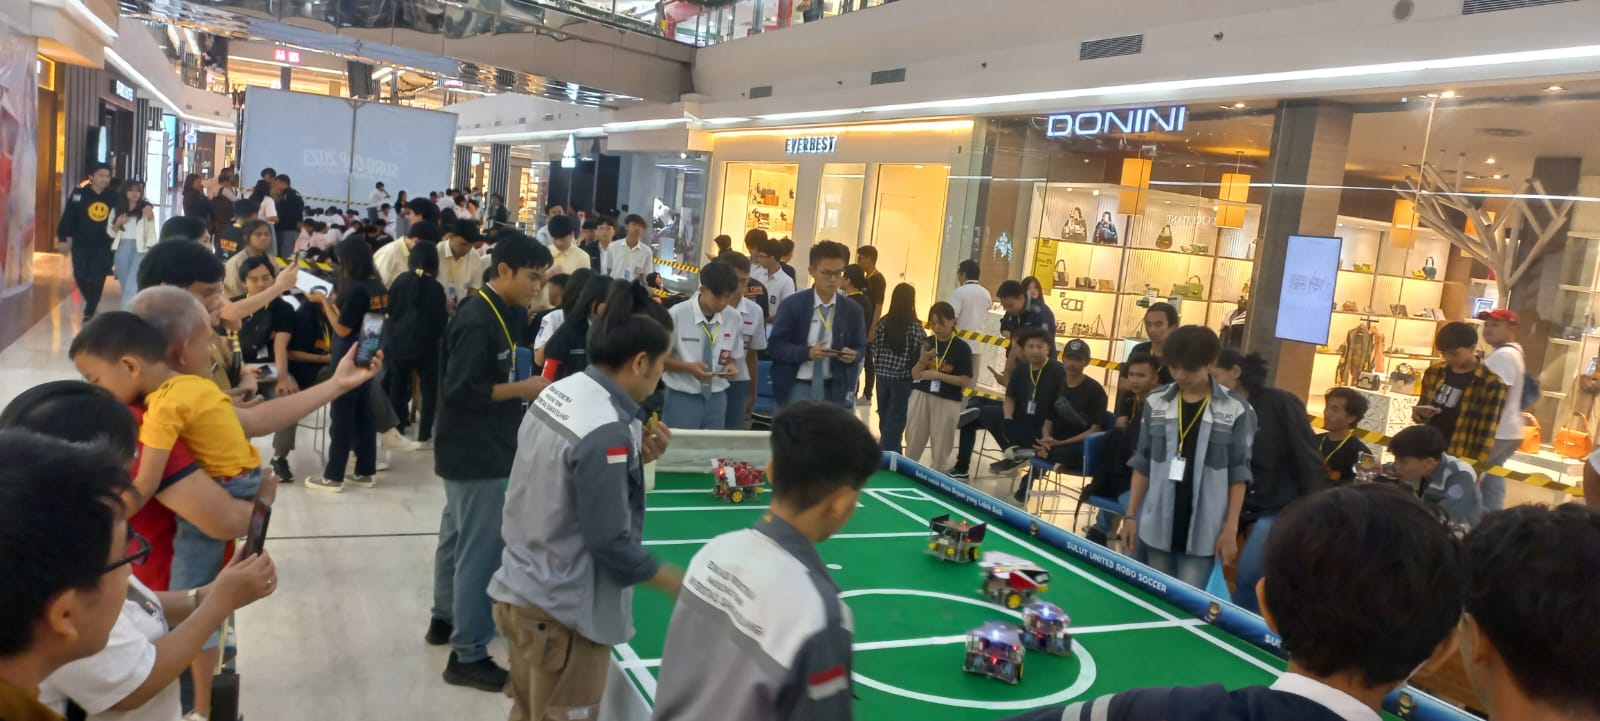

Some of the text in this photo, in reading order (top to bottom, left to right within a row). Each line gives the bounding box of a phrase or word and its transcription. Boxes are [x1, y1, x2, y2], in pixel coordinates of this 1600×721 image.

[1046, 106, 1186, 137] DONINI
[785, 136, 837, 153] EVERBEST
[1066, 541, 1167, 593] SULUT UNITED ROBO SOCCER
